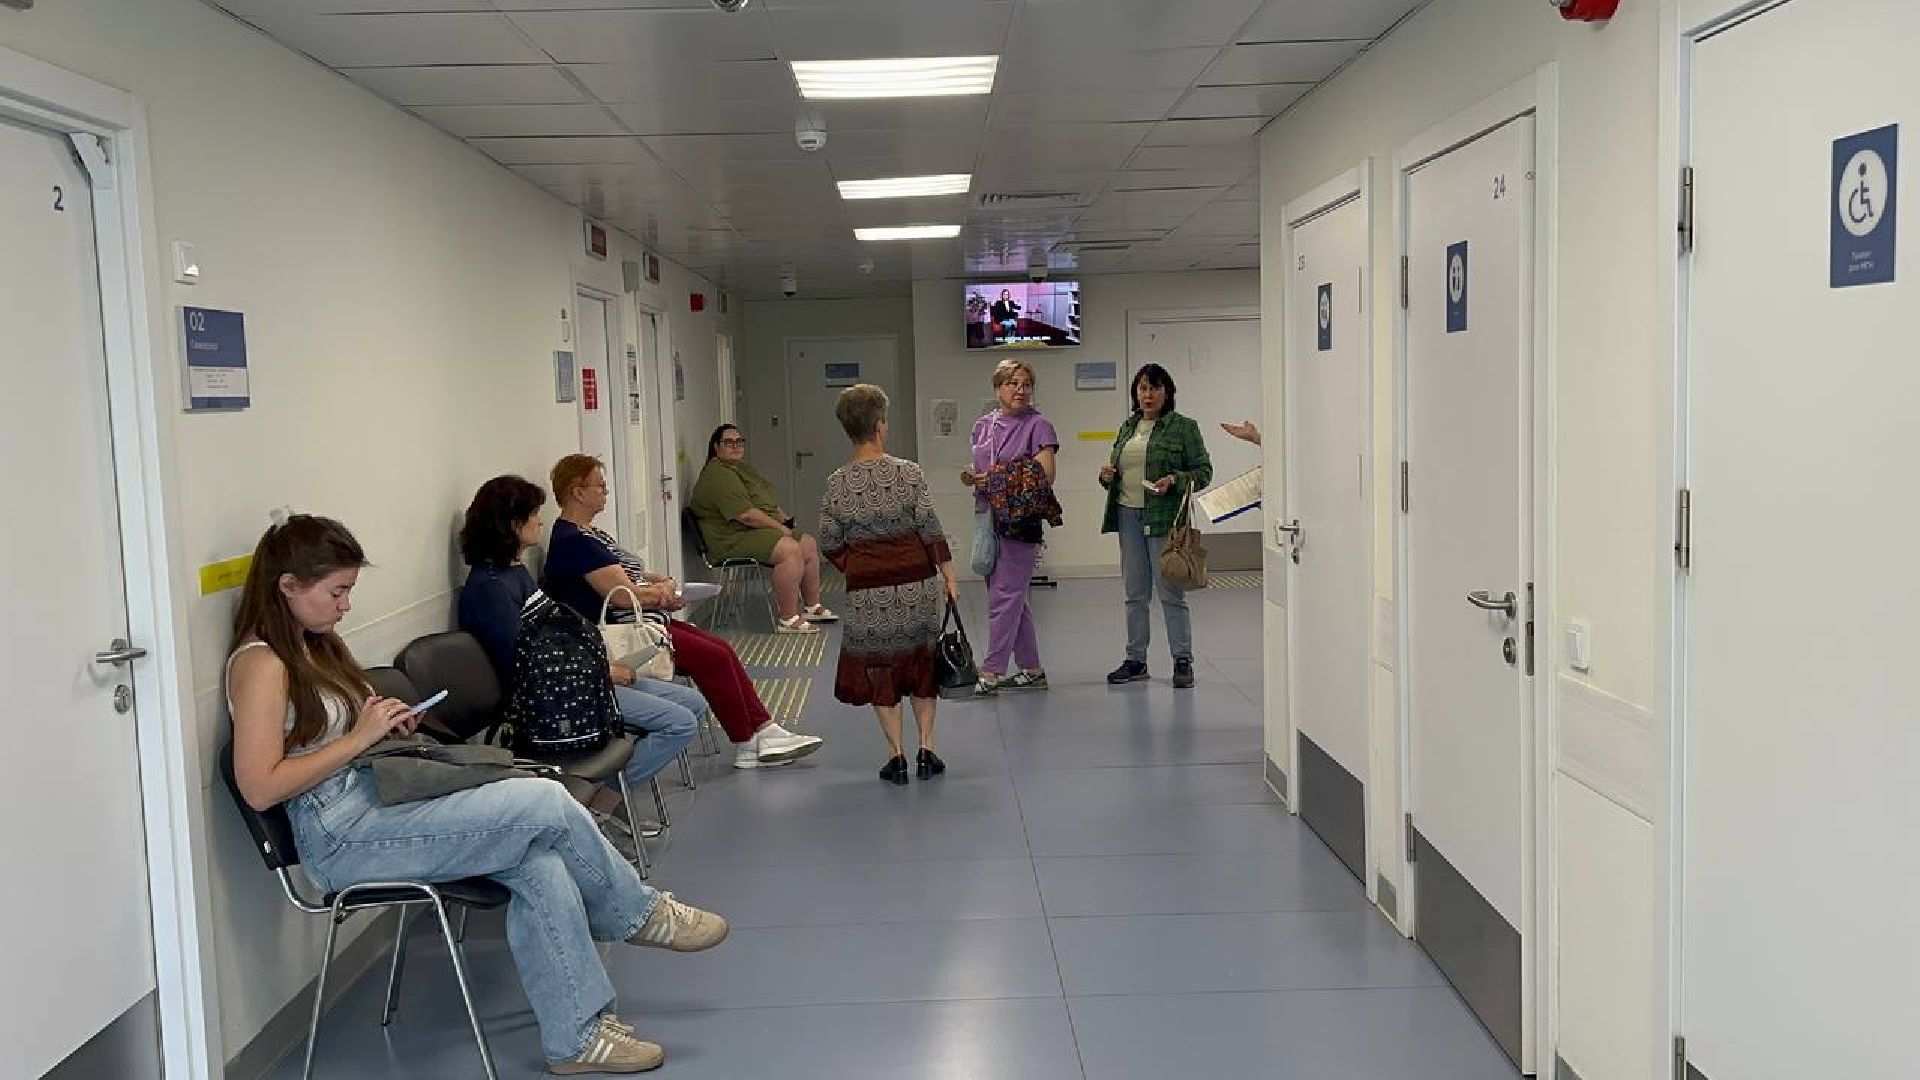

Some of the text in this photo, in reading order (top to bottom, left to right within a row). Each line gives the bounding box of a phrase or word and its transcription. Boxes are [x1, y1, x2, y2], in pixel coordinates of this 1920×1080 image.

[52, 185, 64, 211] 2
[1493, 173, 1507, 200] 24
[189, 311, 205, 332] 02
